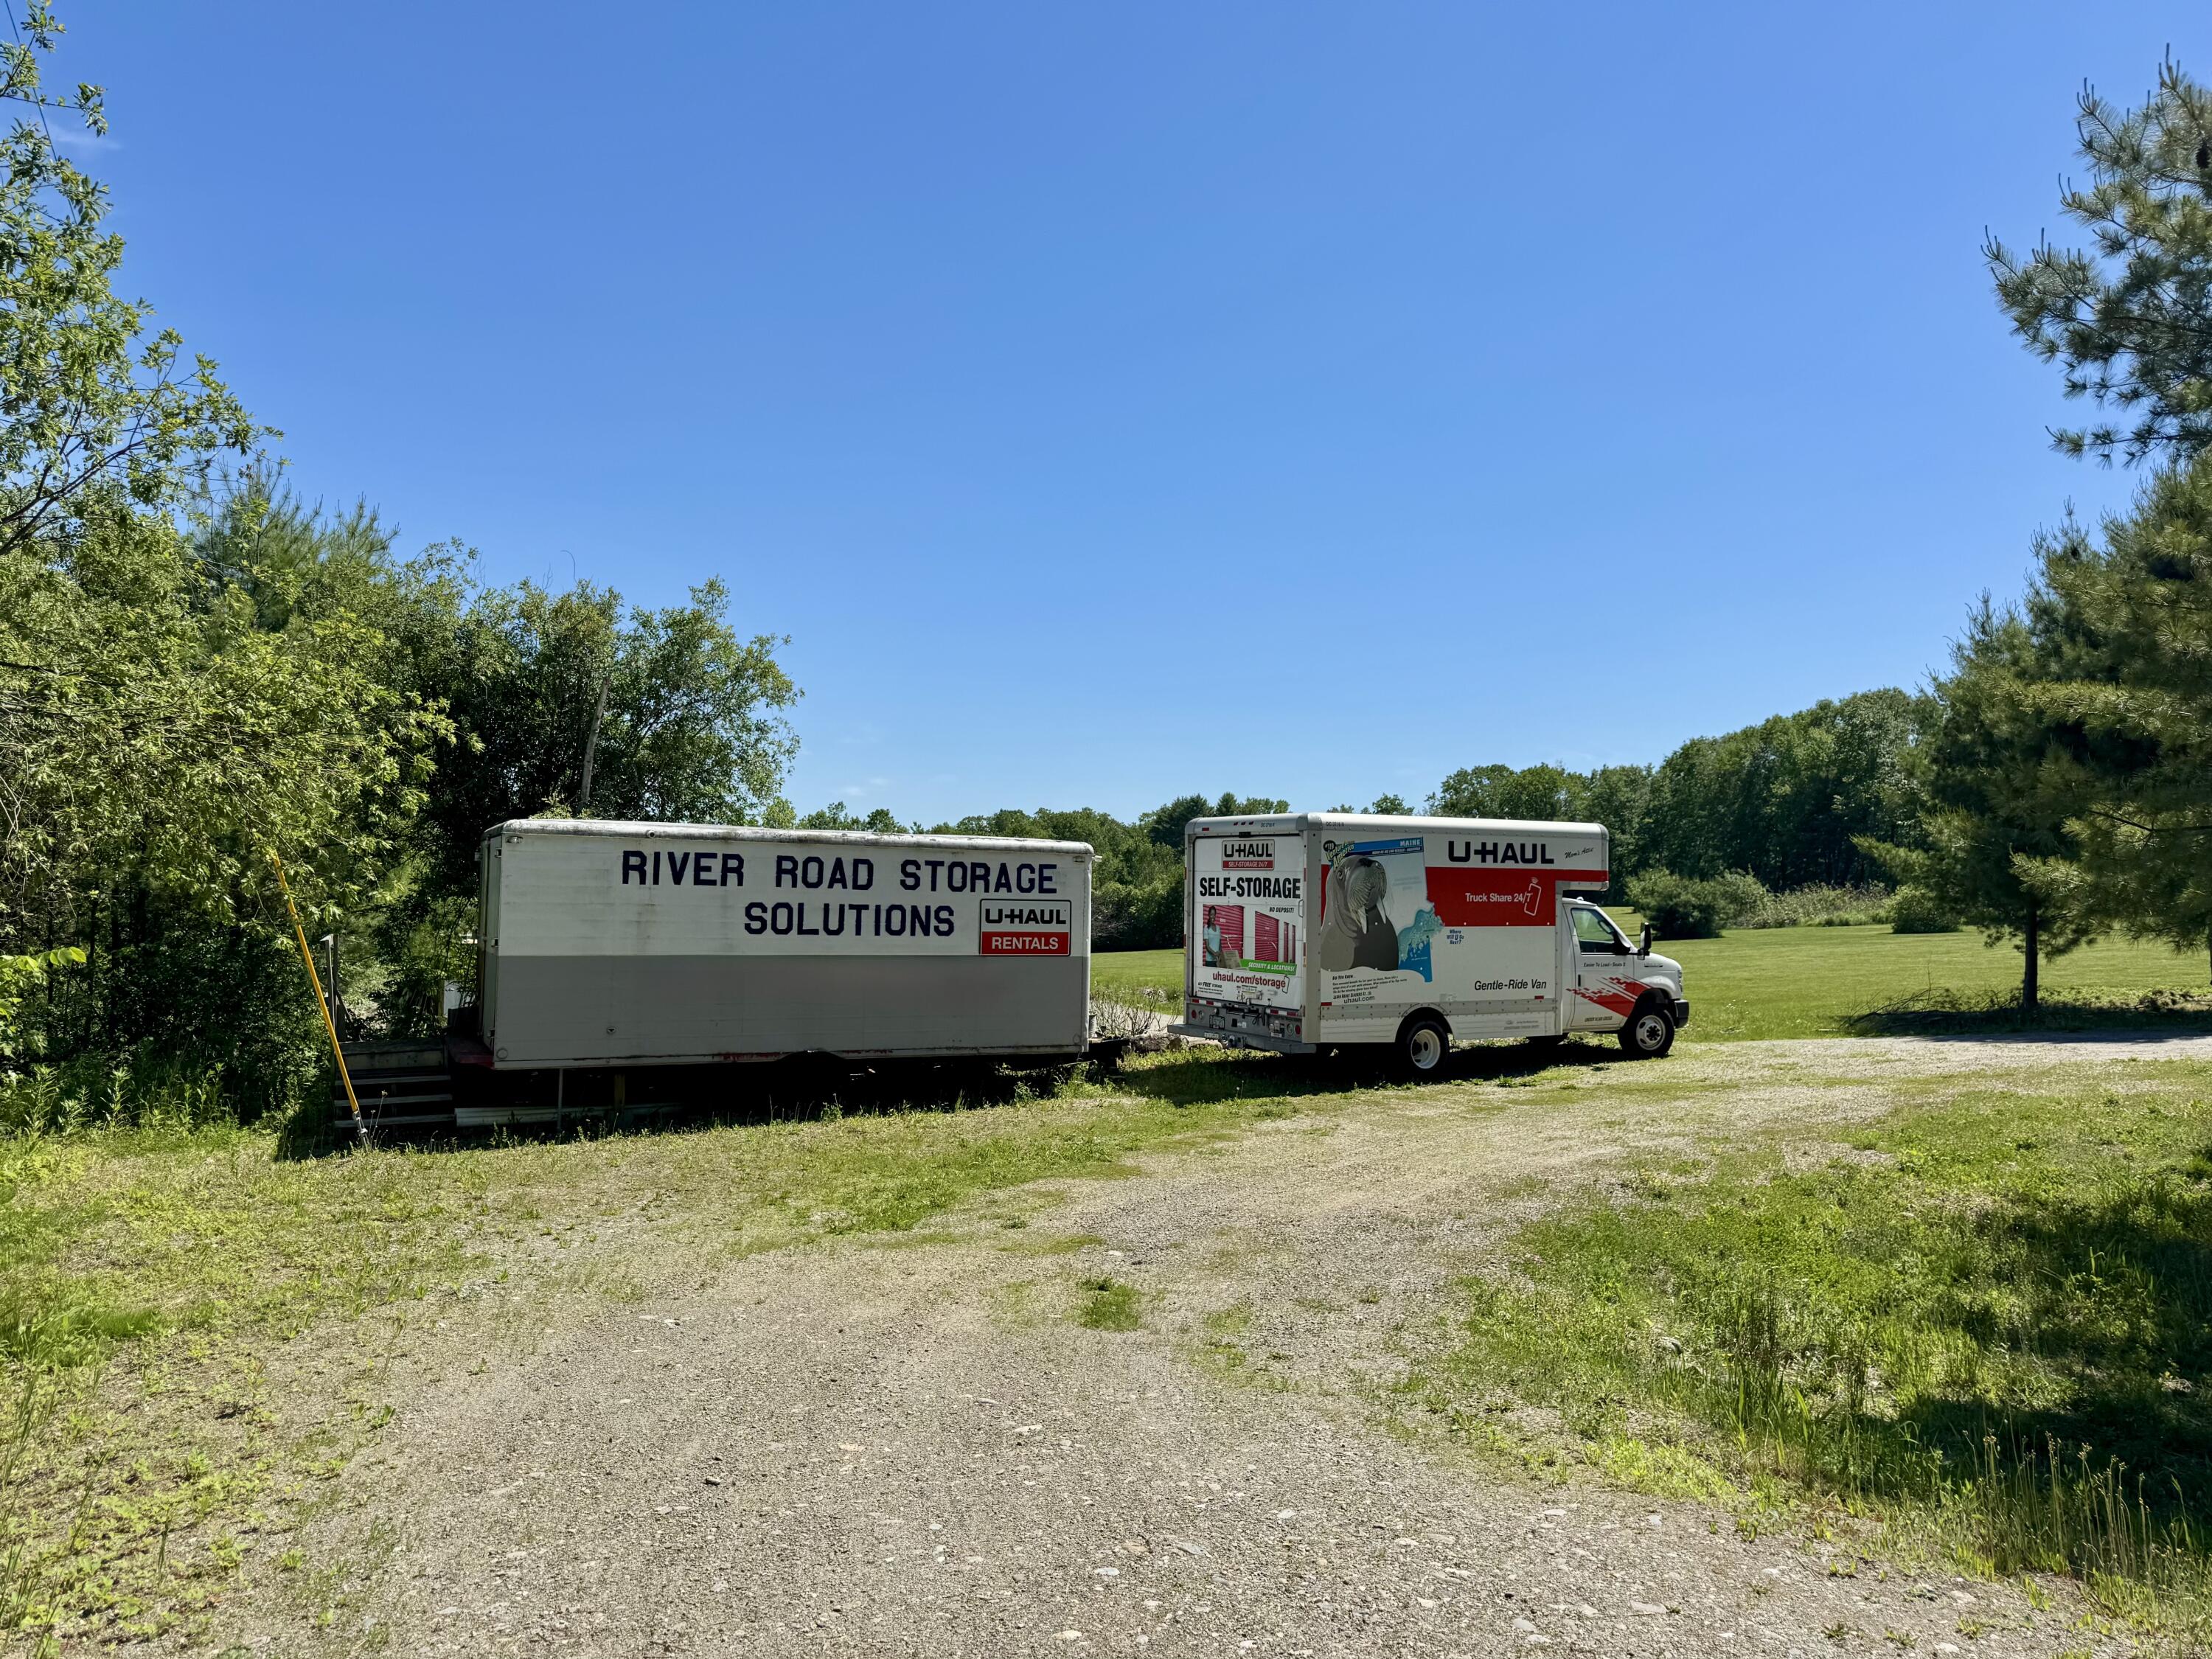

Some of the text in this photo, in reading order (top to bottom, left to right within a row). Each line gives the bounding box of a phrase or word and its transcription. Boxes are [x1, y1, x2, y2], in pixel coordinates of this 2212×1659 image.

[1224, 844, 1272, 858] U-HAUL
[1332, 844, 1355, 871] America
[1448, 841, 1554, 864] U-HAUL
[622, 850, 1057, 894] RIVER ROAD STORAGE
[1200, 877, 1301, 899] SELF-STORAGE
[1465, 893, 1487, 902] Truck
[1489, 893, 1512, 902] Share
[744, 902, 955, 936] SOLUTIONS
[985, 908, 1067, 925] U-HAUL
[992, 937, 1058, 950] RENTALS
[1213, 971, 1286, 990] uhaul.com/storage
[1475, 979, 1547, 991] Gentle-Ride Van
